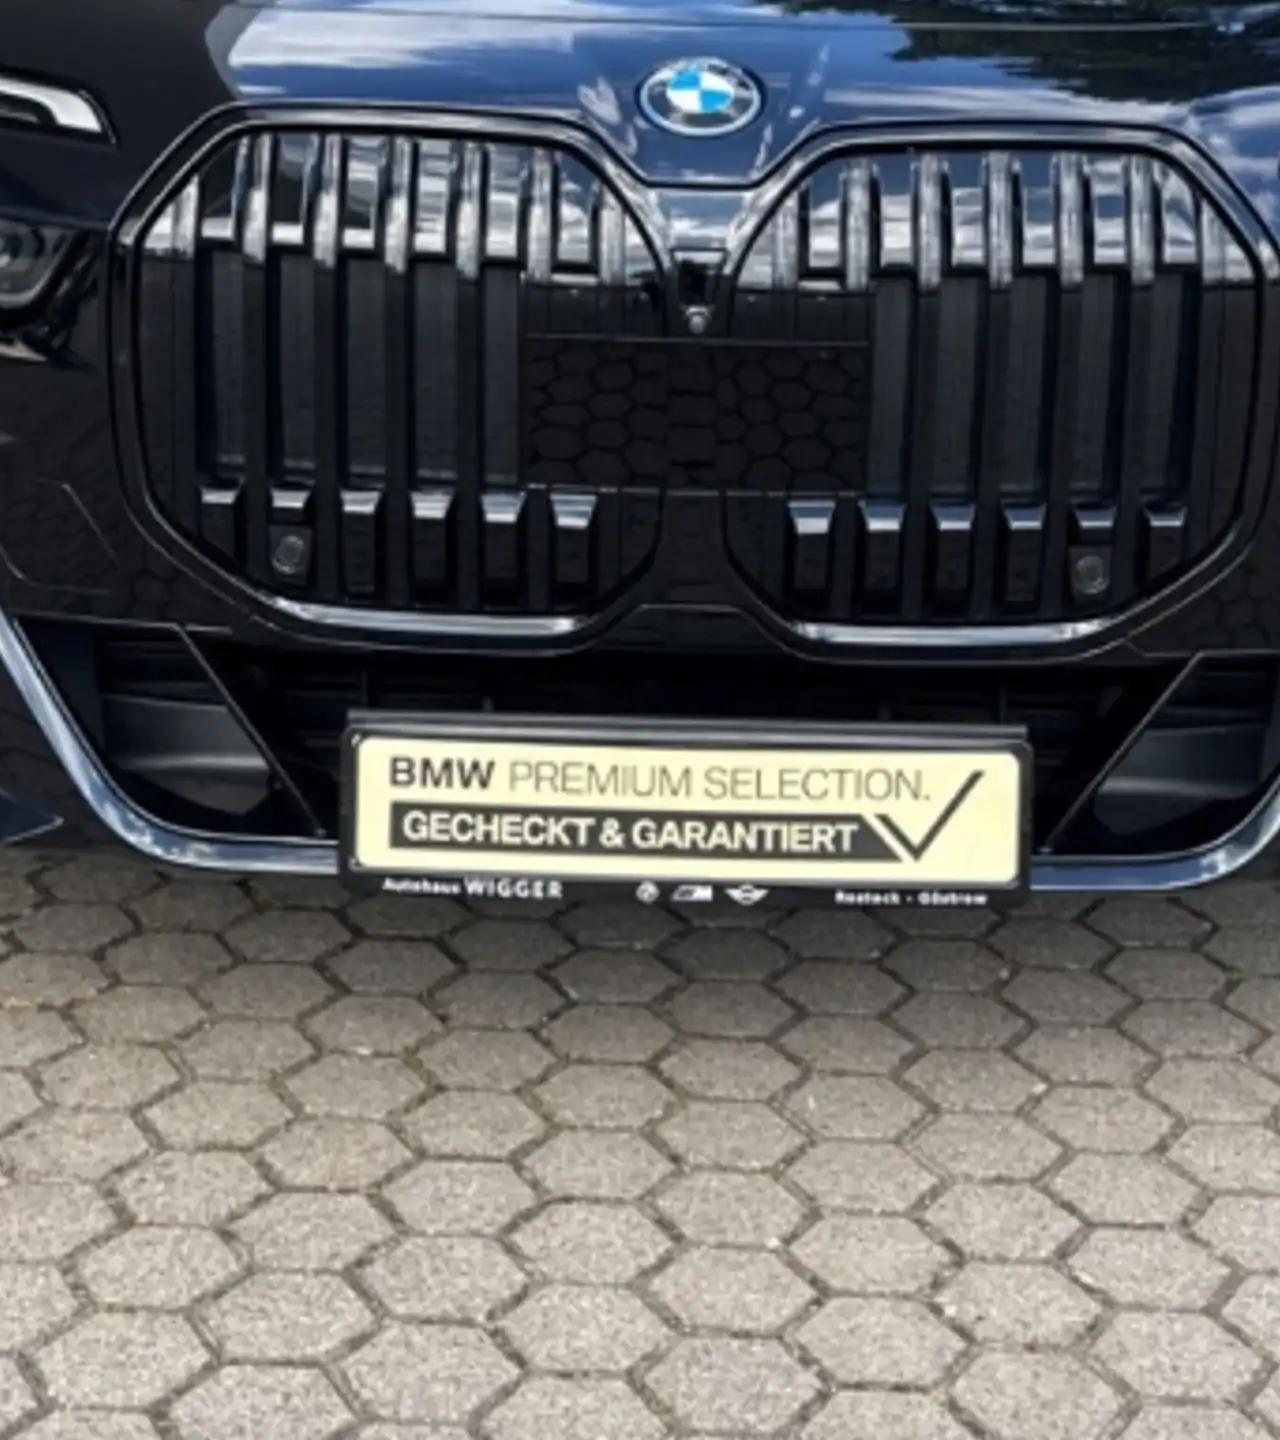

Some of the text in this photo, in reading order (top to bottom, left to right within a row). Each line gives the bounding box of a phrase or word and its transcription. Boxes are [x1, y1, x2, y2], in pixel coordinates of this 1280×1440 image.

[389, 756, 931, 802] BMW PREMIUM SELECTION.
[402, 809, 859, 853] GECHECKT & GARANTIERT
[464, 875, 563, 900] WIGGER
